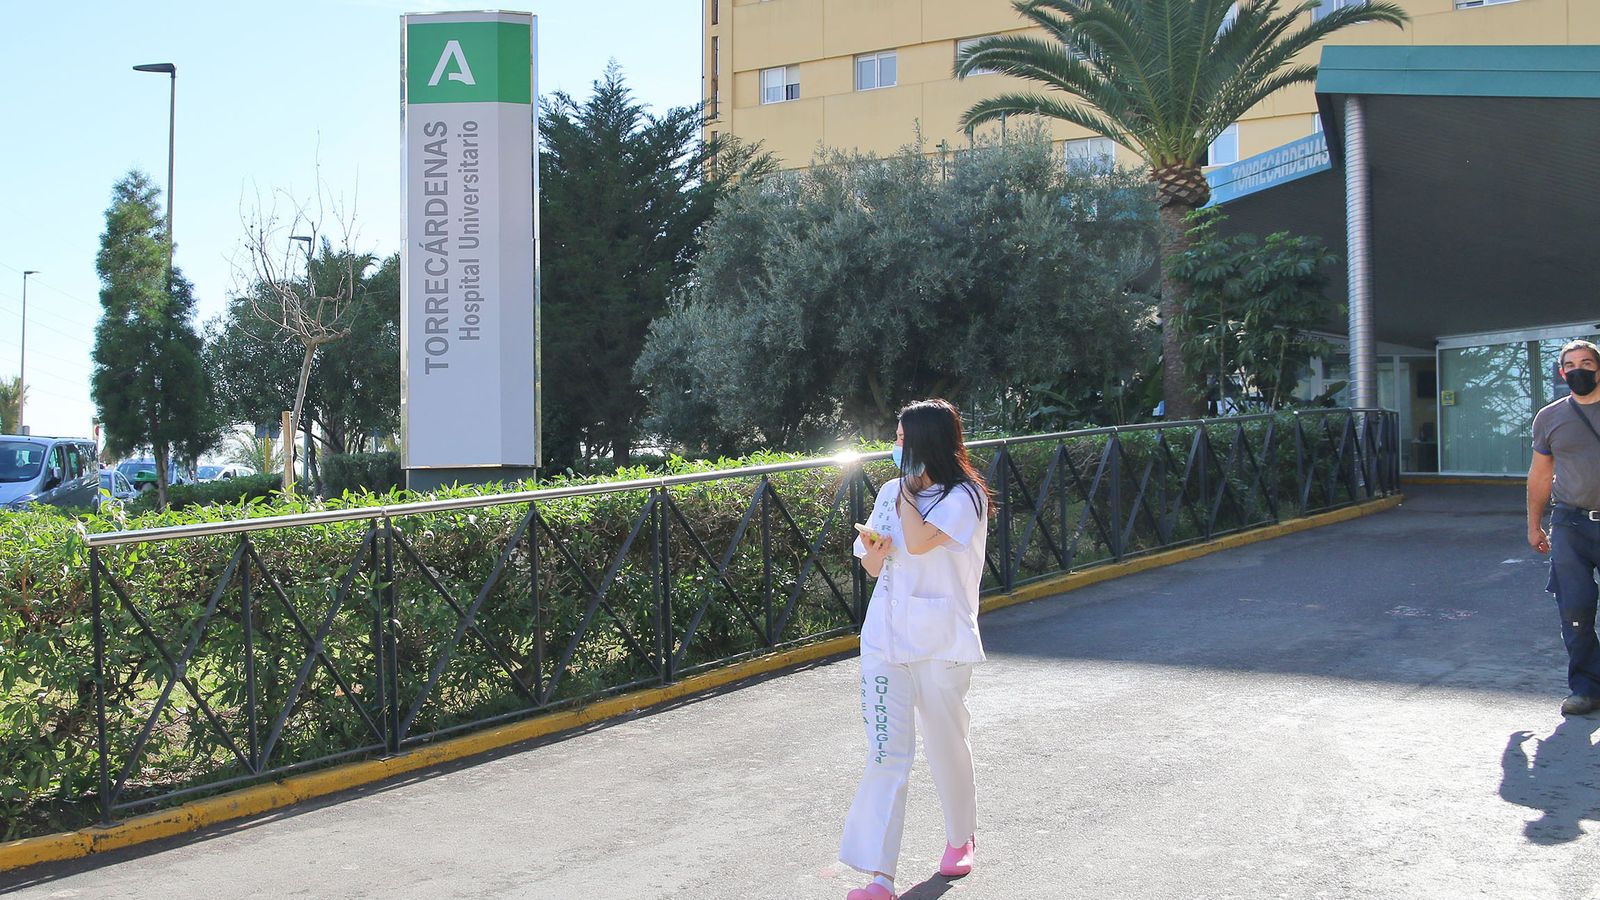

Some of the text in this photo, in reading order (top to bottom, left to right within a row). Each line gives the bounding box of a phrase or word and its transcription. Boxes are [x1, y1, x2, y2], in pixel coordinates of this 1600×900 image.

[458, 120, 485, 341] Hospital Universitario
[1232, 136, 1330, 193] TORRECARDENAS
[419, 120, 449, 375] TORRECÁRDENAS
[874, 675, 889, 764] QUIRURGICA
